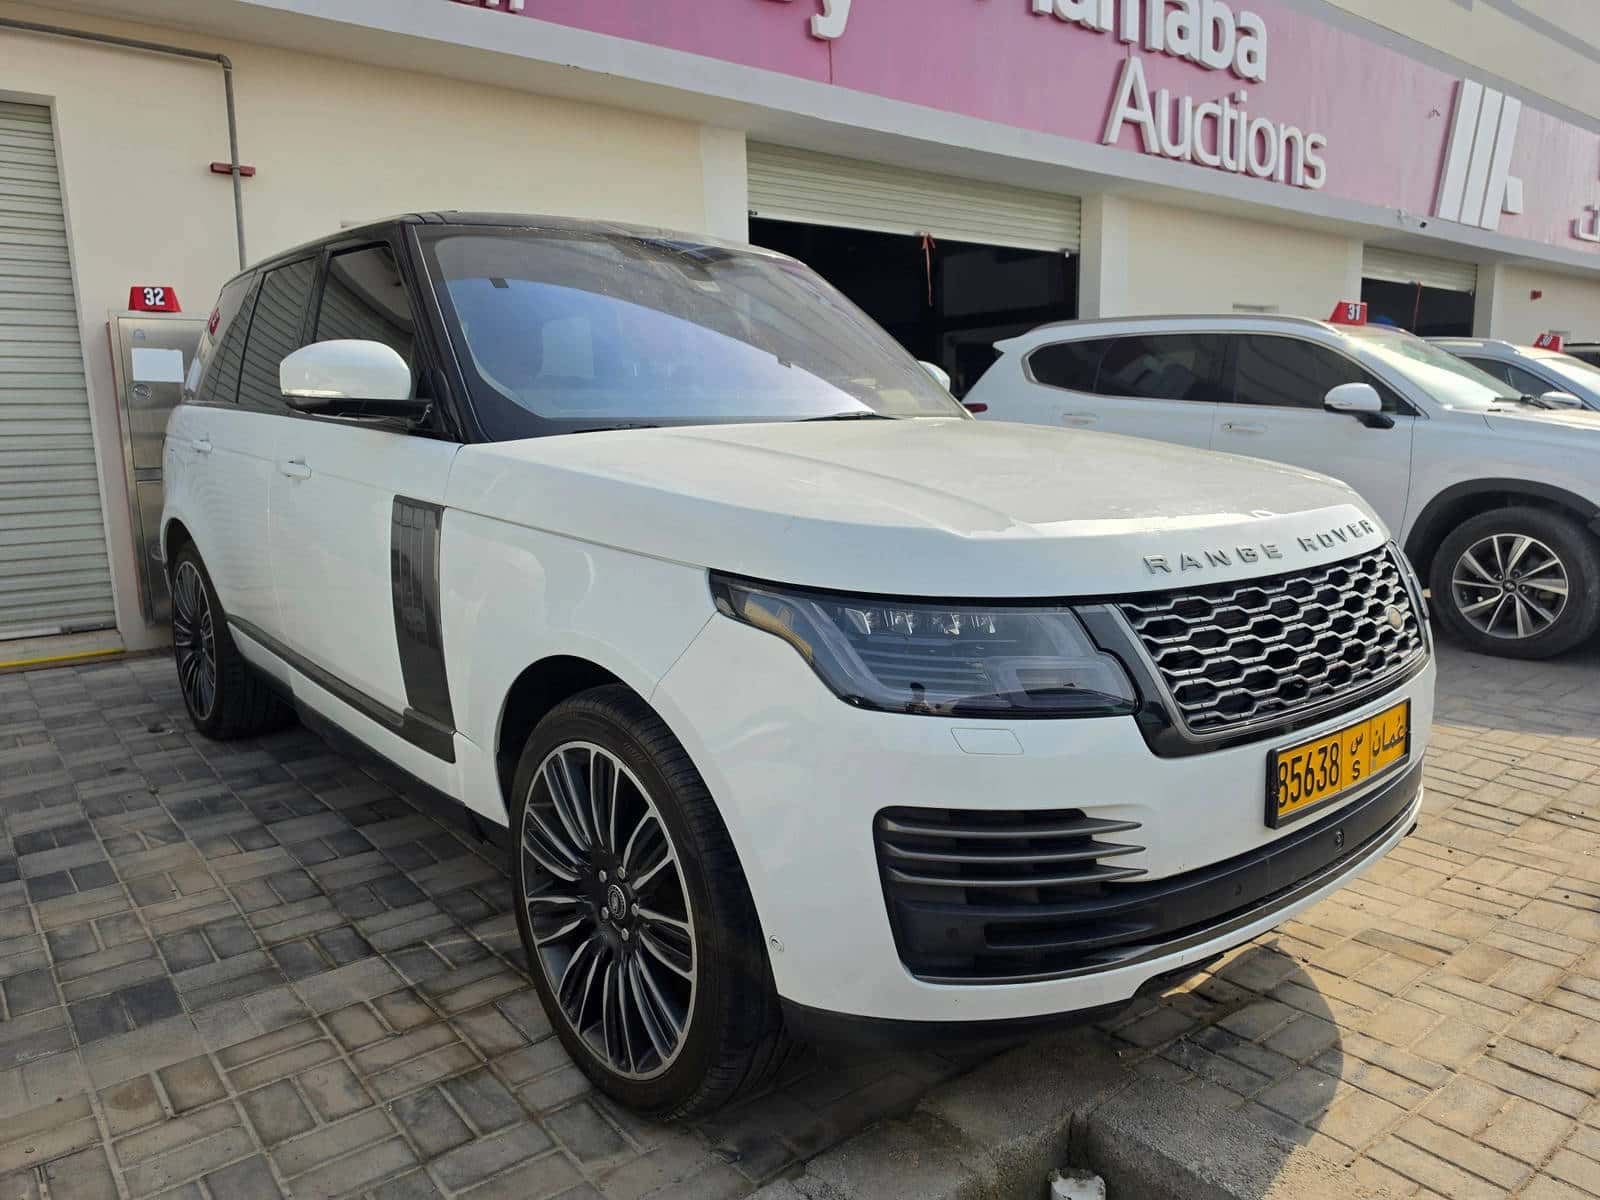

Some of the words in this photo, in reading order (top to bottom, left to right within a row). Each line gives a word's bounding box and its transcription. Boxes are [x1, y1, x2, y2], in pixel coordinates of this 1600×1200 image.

[1102, 55, 1327, 190] Auctions
[143, 287, 165, 306] 32
[1347, 303, 1360, 321] 31
[1142, 543, 1284, 575] RANGE
[1297, 519, 1375, 552] ROVER
[1278, 742, 1340, 808] 85638
[1352, 759, 1361, 780] S
